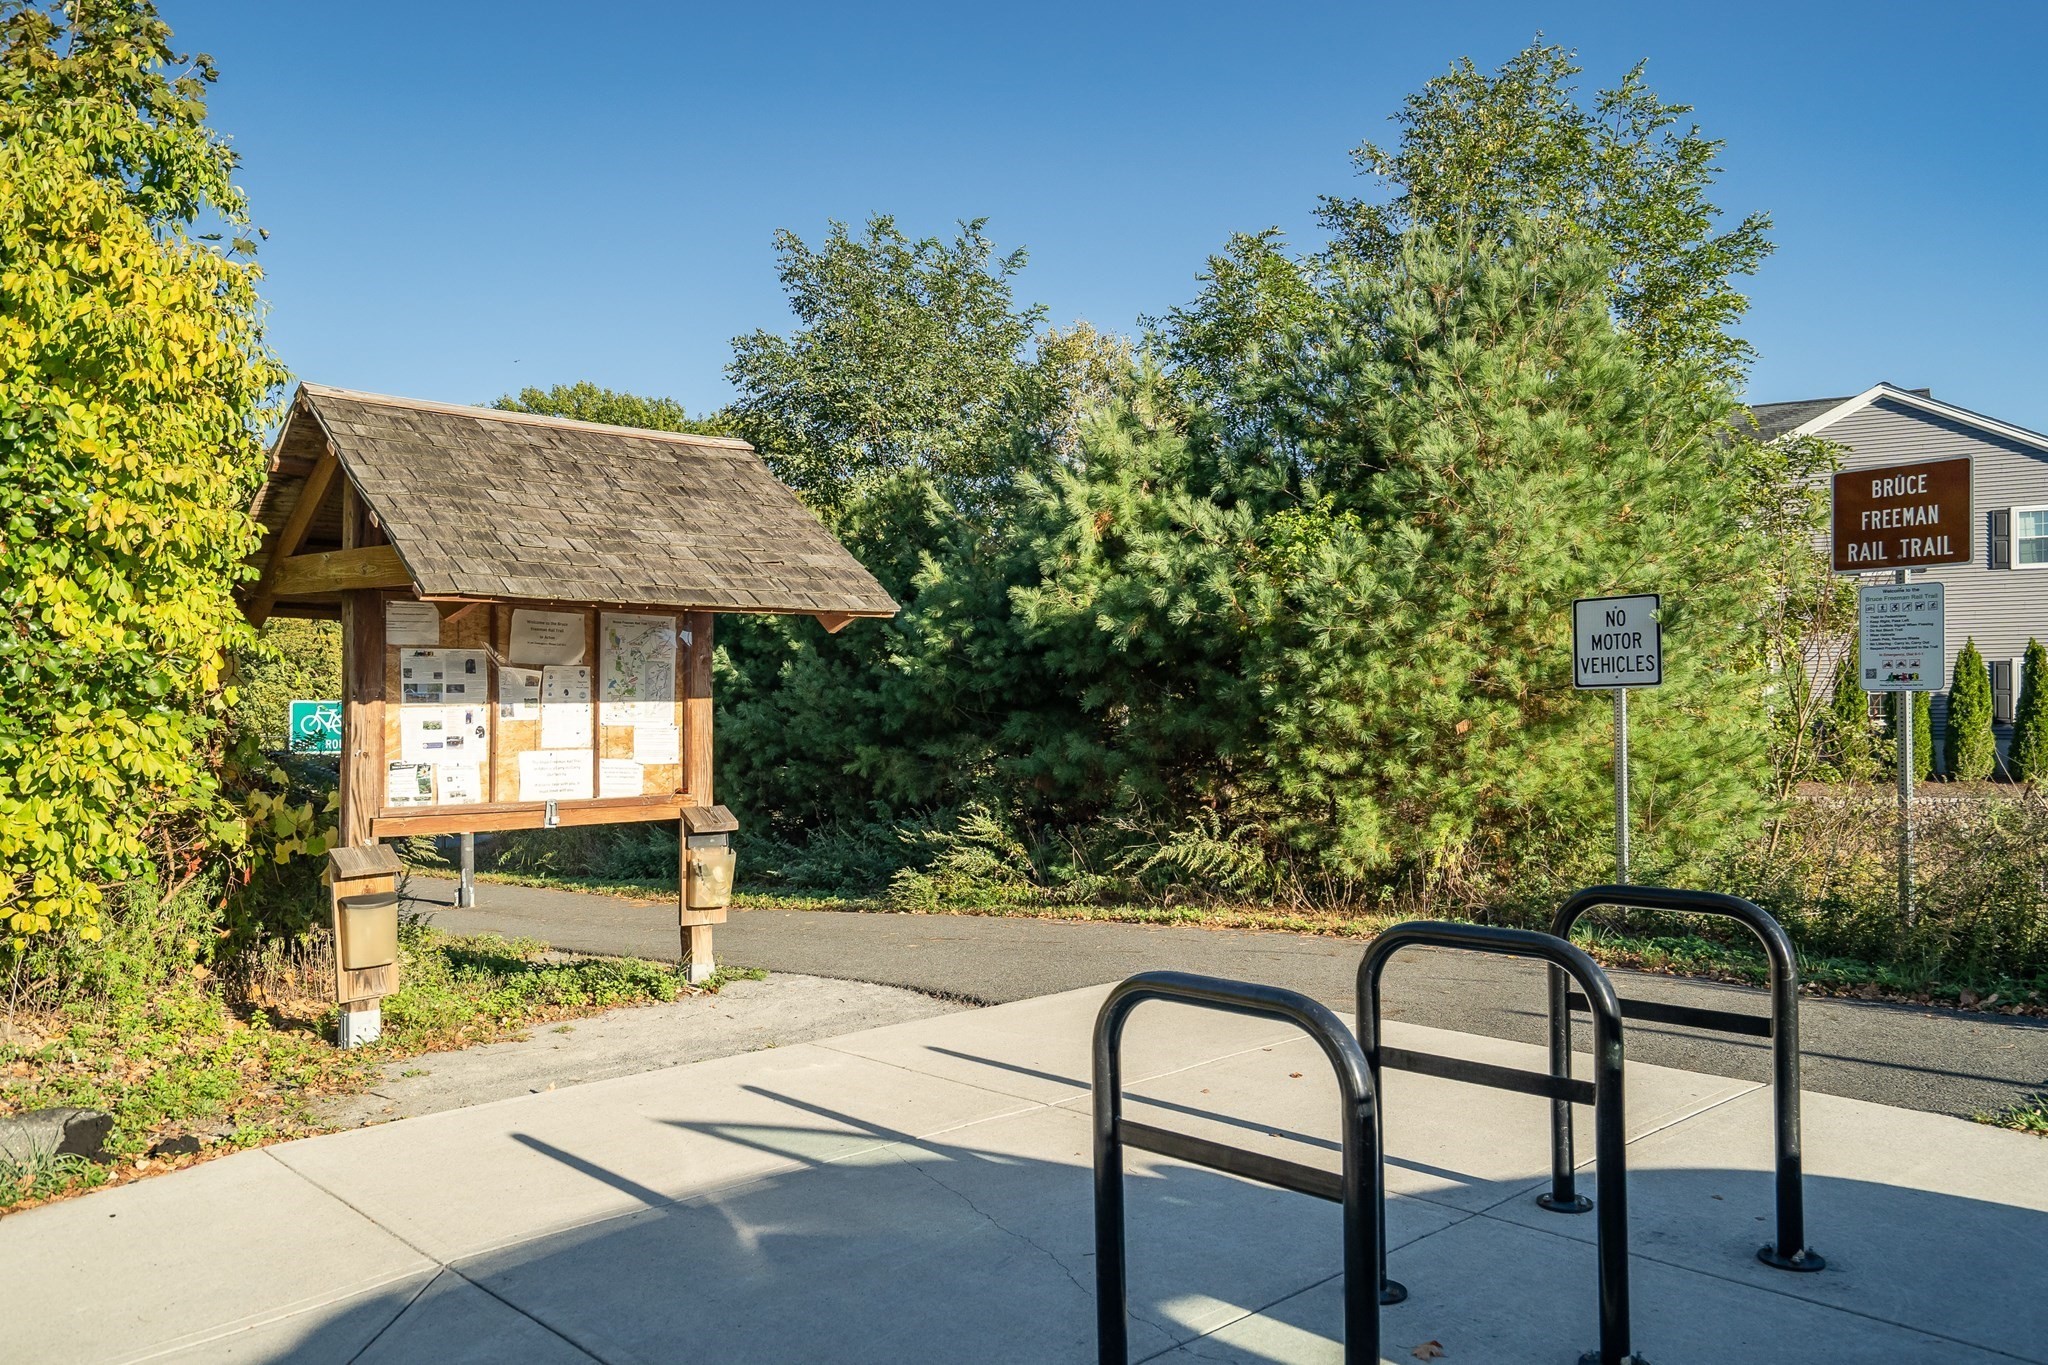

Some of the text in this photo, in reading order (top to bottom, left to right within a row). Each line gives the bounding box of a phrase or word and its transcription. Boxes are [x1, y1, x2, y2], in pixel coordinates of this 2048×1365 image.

[1871, 474, 1928, 499] BRUCE
[1861, 504, 1939, 531] FREEMAN
[1847, 535, 1954, 562] RAIL TRAIL
[1606, 609, 1626, 628] NO
[1591, 632, 1642, 651] MOTOR
[1580, 654, 1655, 674] VEHICLES
